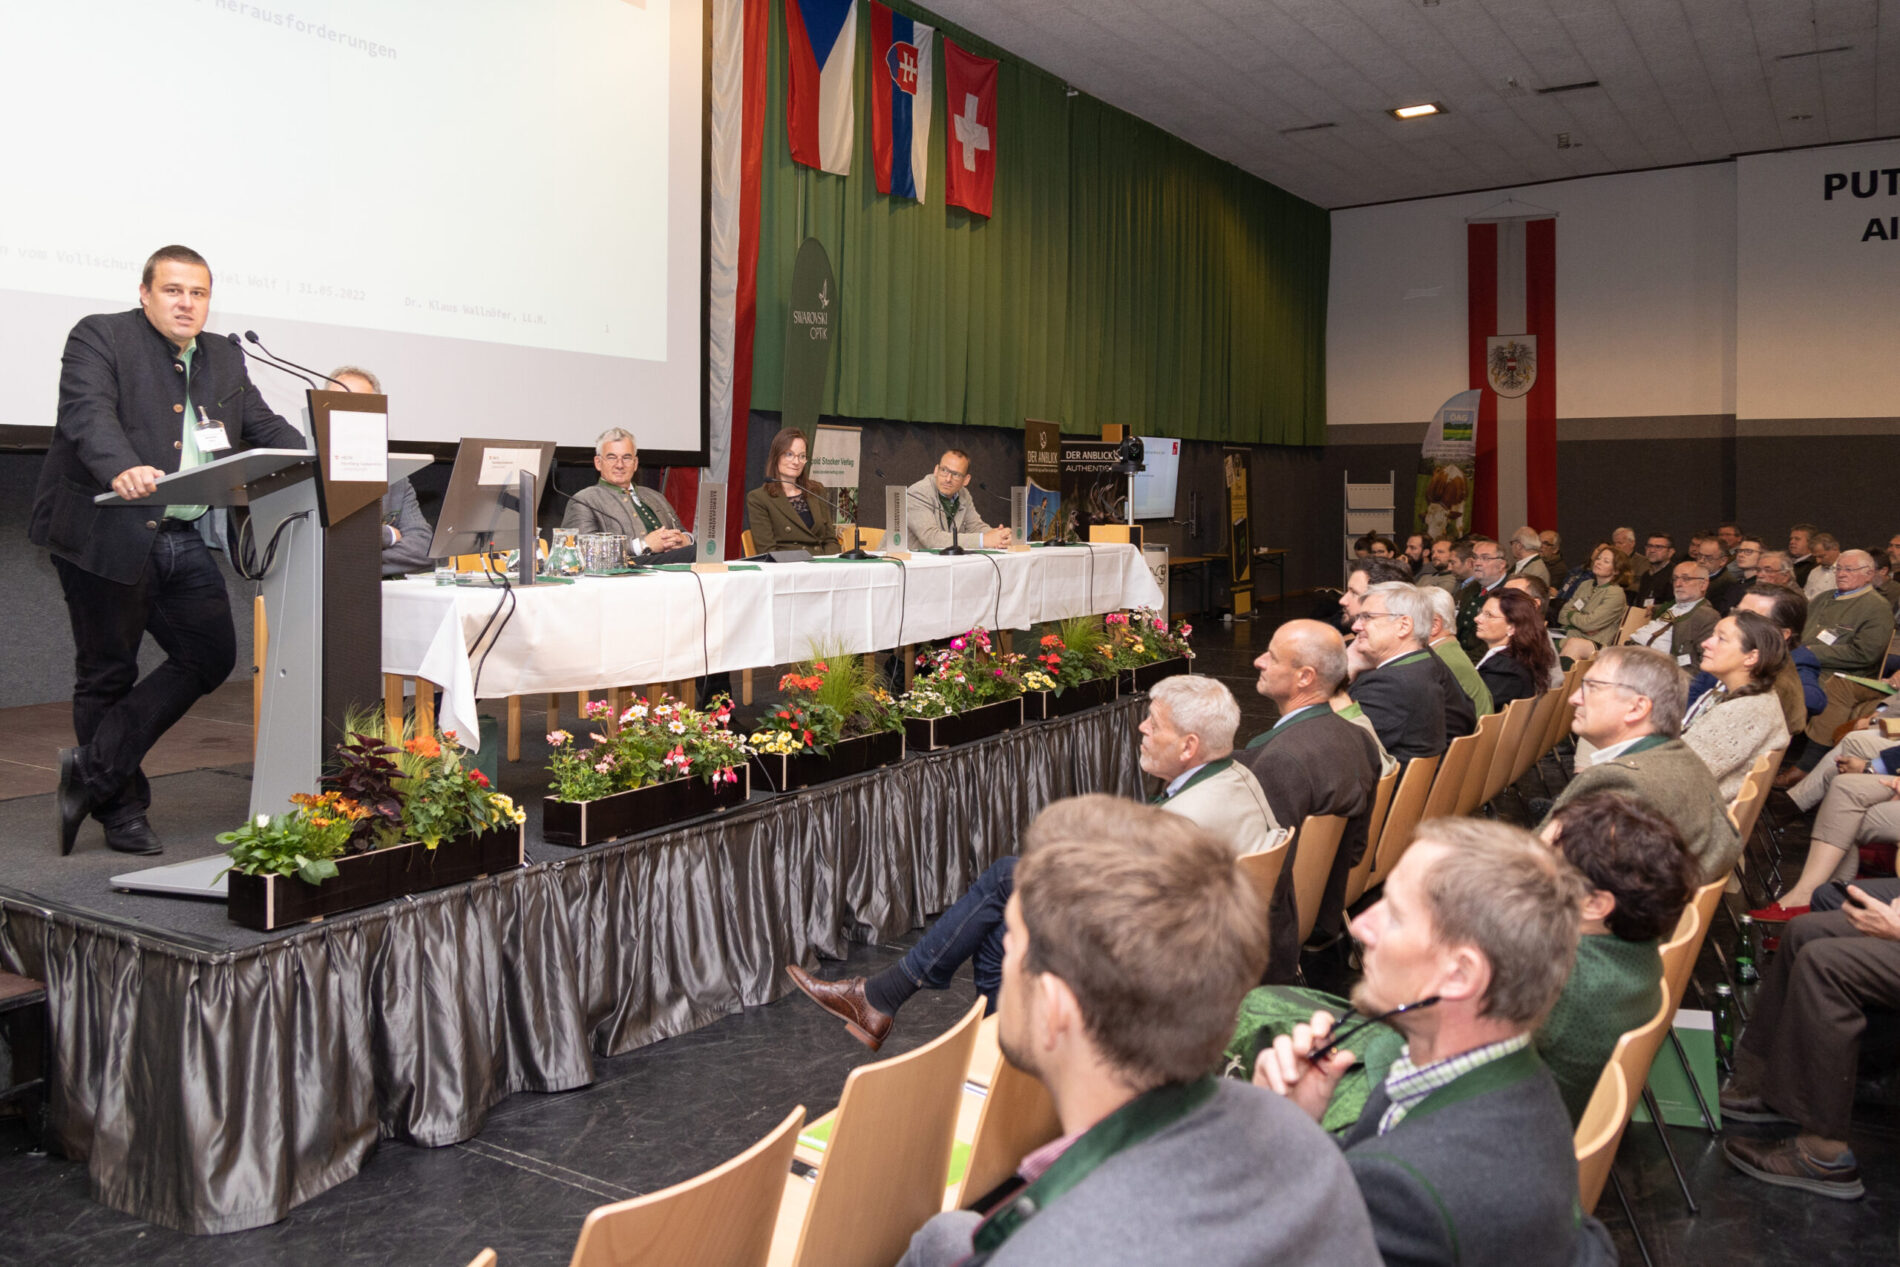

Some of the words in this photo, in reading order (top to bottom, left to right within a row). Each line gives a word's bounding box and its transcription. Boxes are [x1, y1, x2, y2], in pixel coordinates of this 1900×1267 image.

[1824, 168, 1900, 200] PUT
[1861, 216, 1899, 242] AI
[404, 296, 422, 308] Dr.
[428, 300, 458, 313] Klaus
[793, 310, 828, 325] SWAROVSKI
[809, 327, 828, 341] OPTIK
[822, 456, 840, 466] Stocker
[1027, 450, 1038, 463] DER
[1065, 450, 1081, 460] DER
[1082, 450, 1114, 460] ANBLICK
